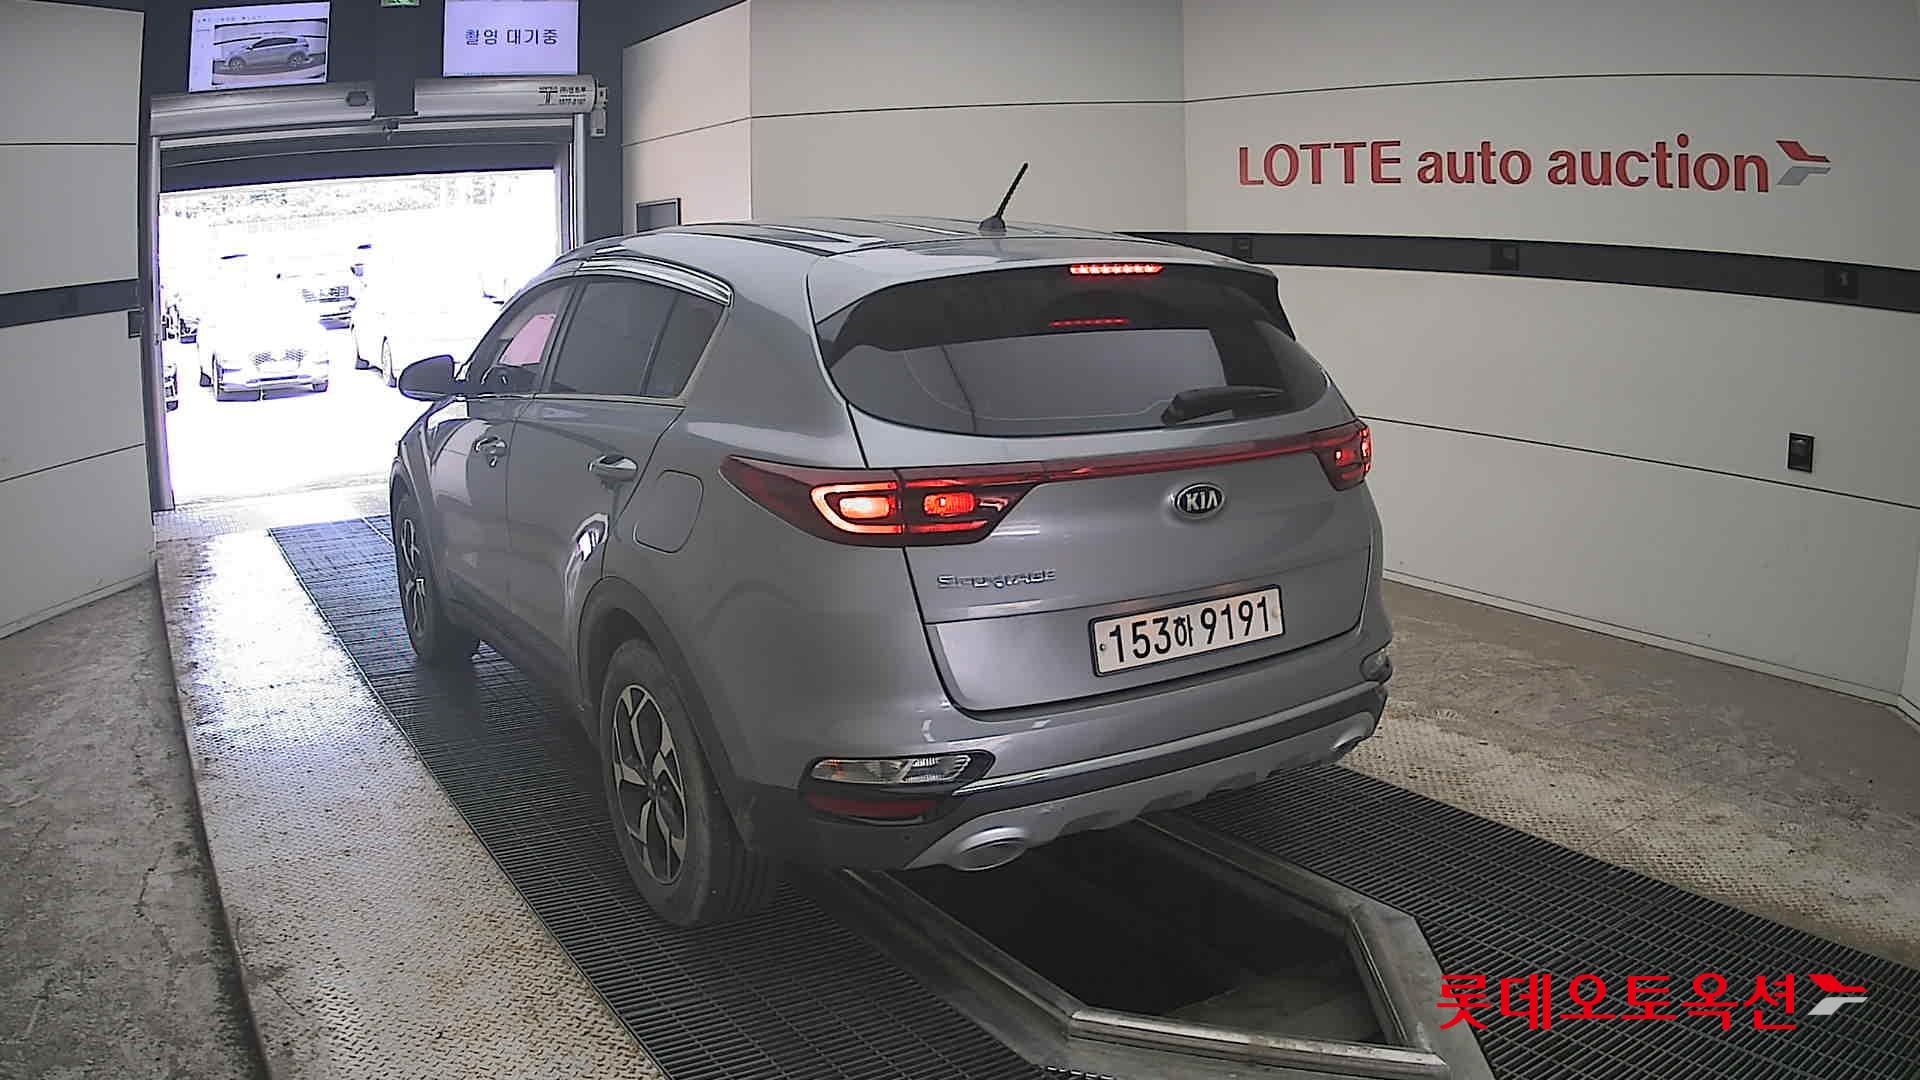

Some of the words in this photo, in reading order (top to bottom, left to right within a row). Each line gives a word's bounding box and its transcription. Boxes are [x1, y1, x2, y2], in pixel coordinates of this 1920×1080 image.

[506, 28, 558, 46] 대기중
[1239, 140, 1401, 187] LOTTE
[1417, 141, 1532, 186] auto
[1547, 132, 1770, 193] auction
[1185, 490, 1219, 514] KIA
[1200, 596, 1272, 645] 9191
